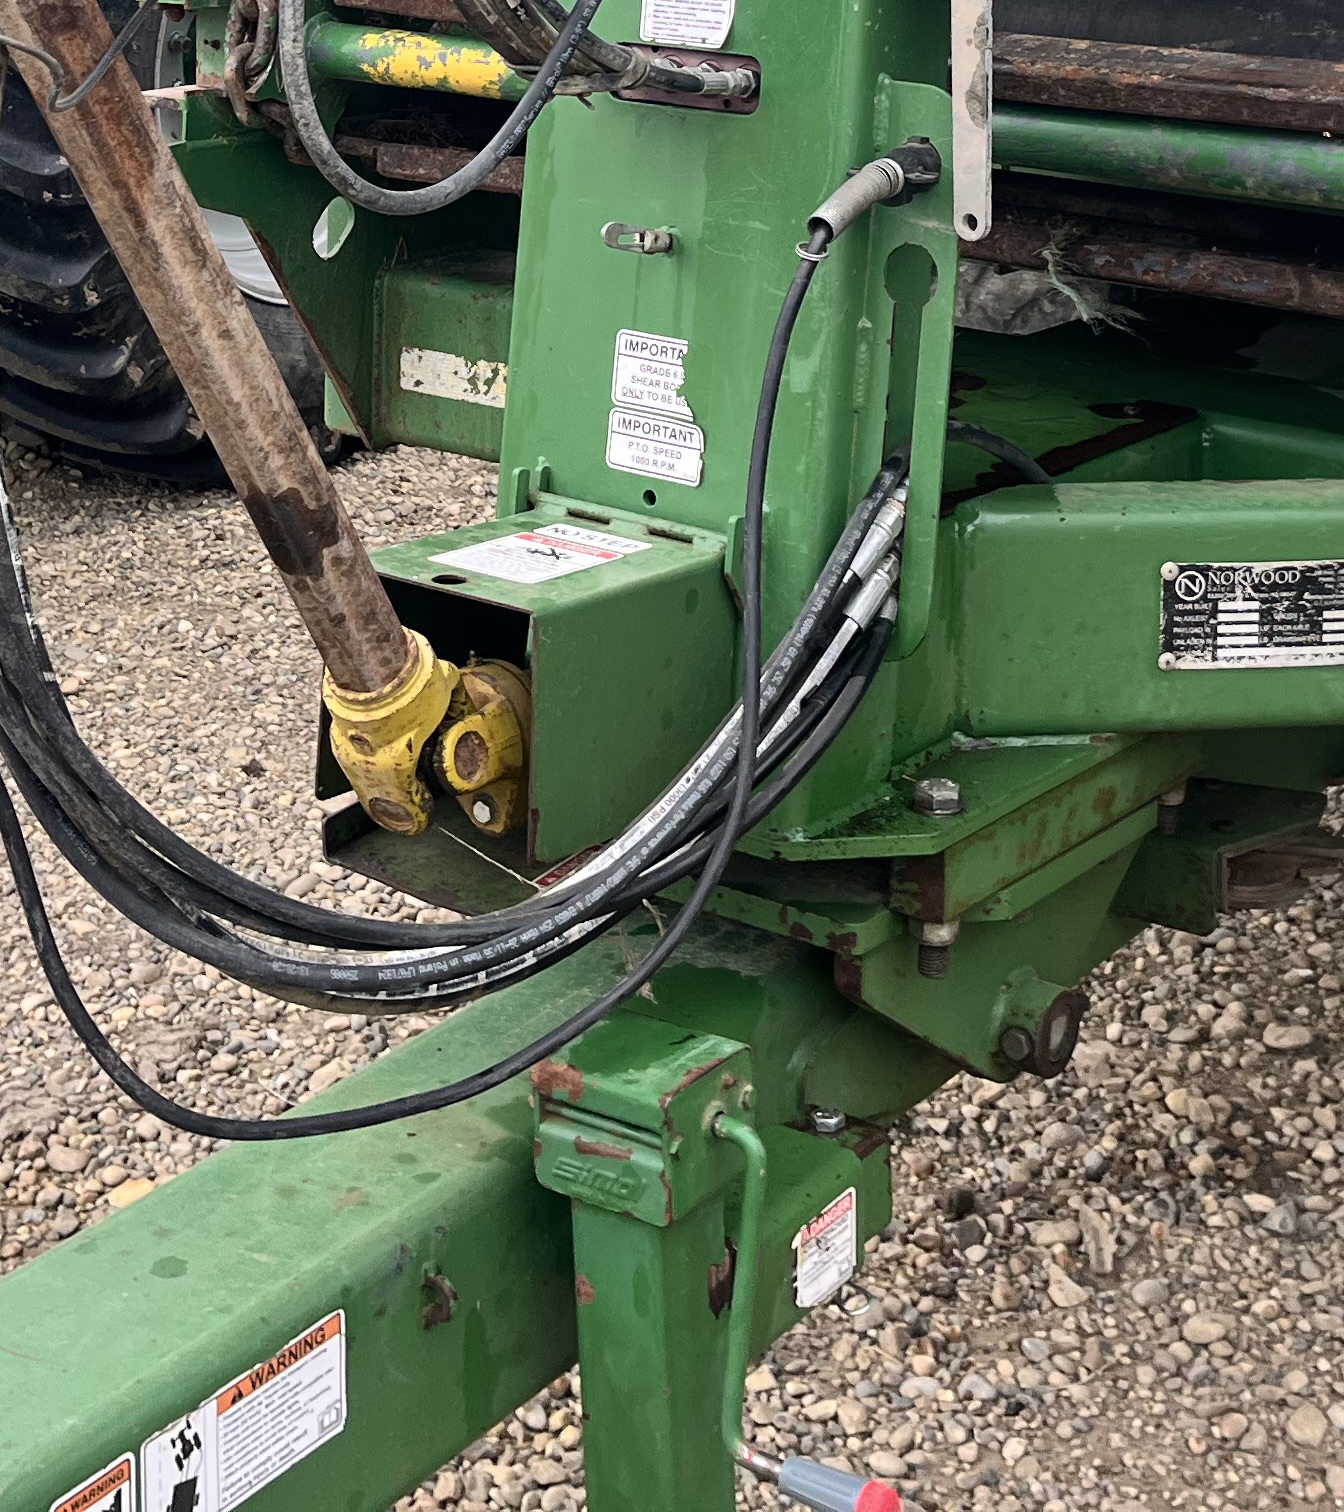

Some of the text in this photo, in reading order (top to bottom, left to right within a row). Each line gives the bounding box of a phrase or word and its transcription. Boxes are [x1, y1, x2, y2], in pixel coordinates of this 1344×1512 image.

[631, 376, 680, 391] SHEAR BO
[622, 387, 644, 399] ONLY
[648, 392, 659, 400] TO
[661, 395, 672, 404] BE
[618, 416, 694, 443] IMPORTANT
[628, 441, 682, 460] P.T.O. SPEED
[631, 455, 649, 466] 1000
[546, 526, 640, 549] NO STEP
[1207, 568, 1300, 586] NORWOOD
[248, 1326, 326, 1391] WARNING
[70, 1469, 124, 1511] WARNING
